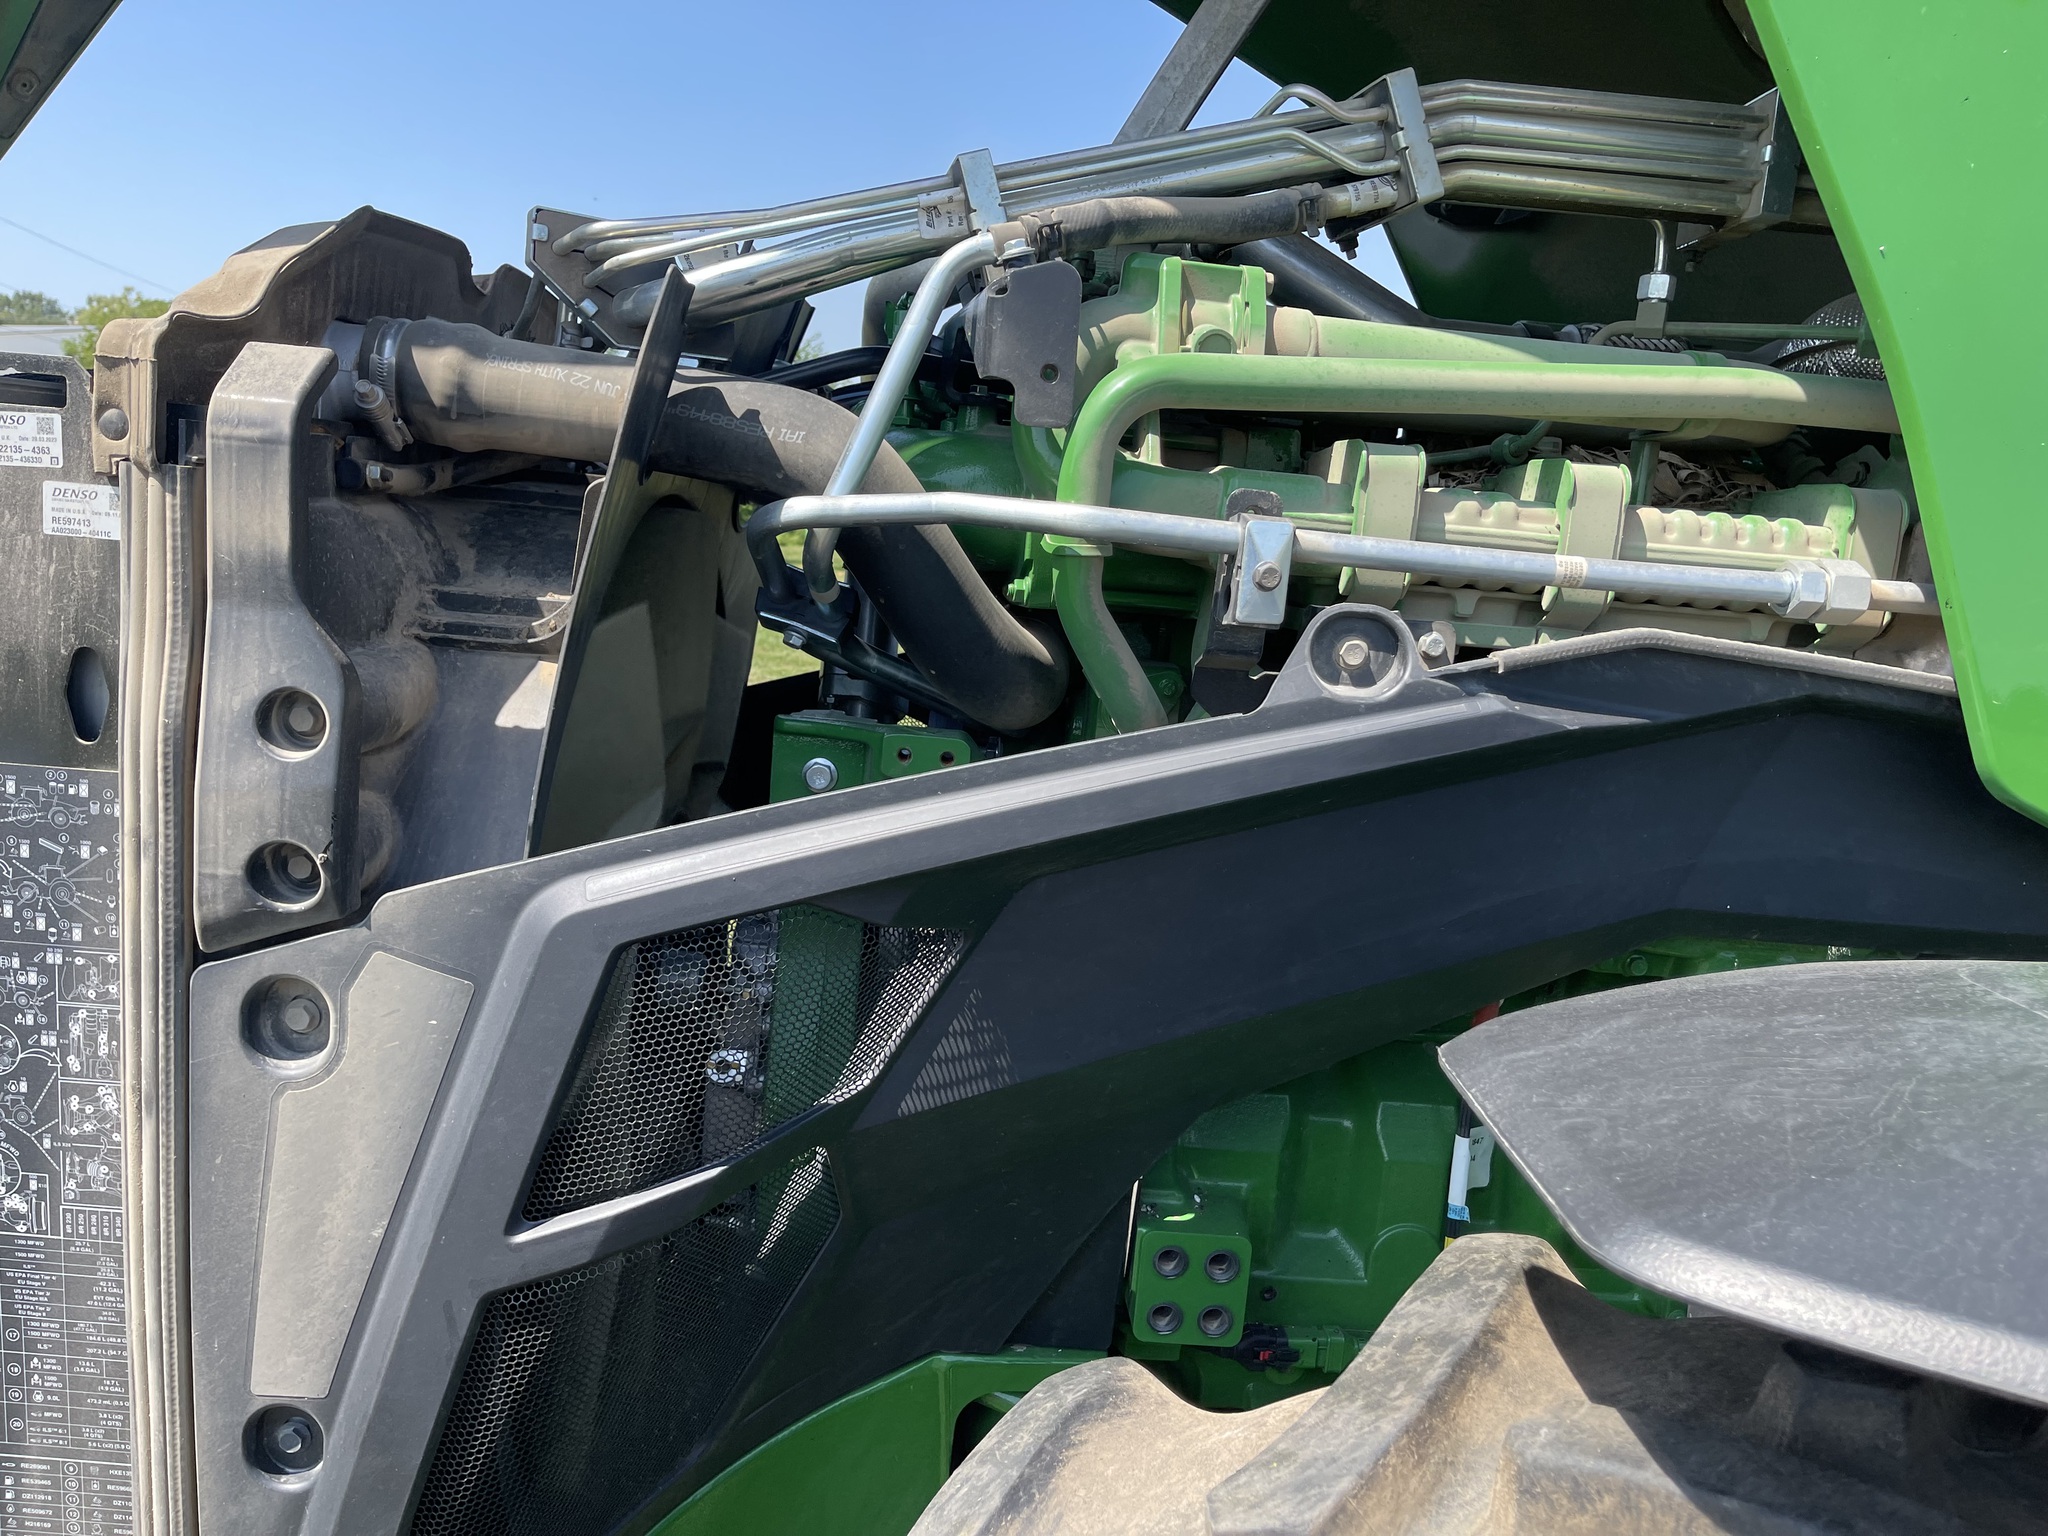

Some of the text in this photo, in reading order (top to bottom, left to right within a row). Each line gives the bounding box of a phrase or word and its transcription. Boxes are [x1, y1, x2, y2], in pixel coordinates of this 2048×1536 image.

[570, 371, 592, 389] 22
[594, 379, 621, 398] JUN
[52, 487, 98, 501] DENSO
[51, 516, 91, 528] RE597413
[1, 1141, 20, 1157] MFWD
